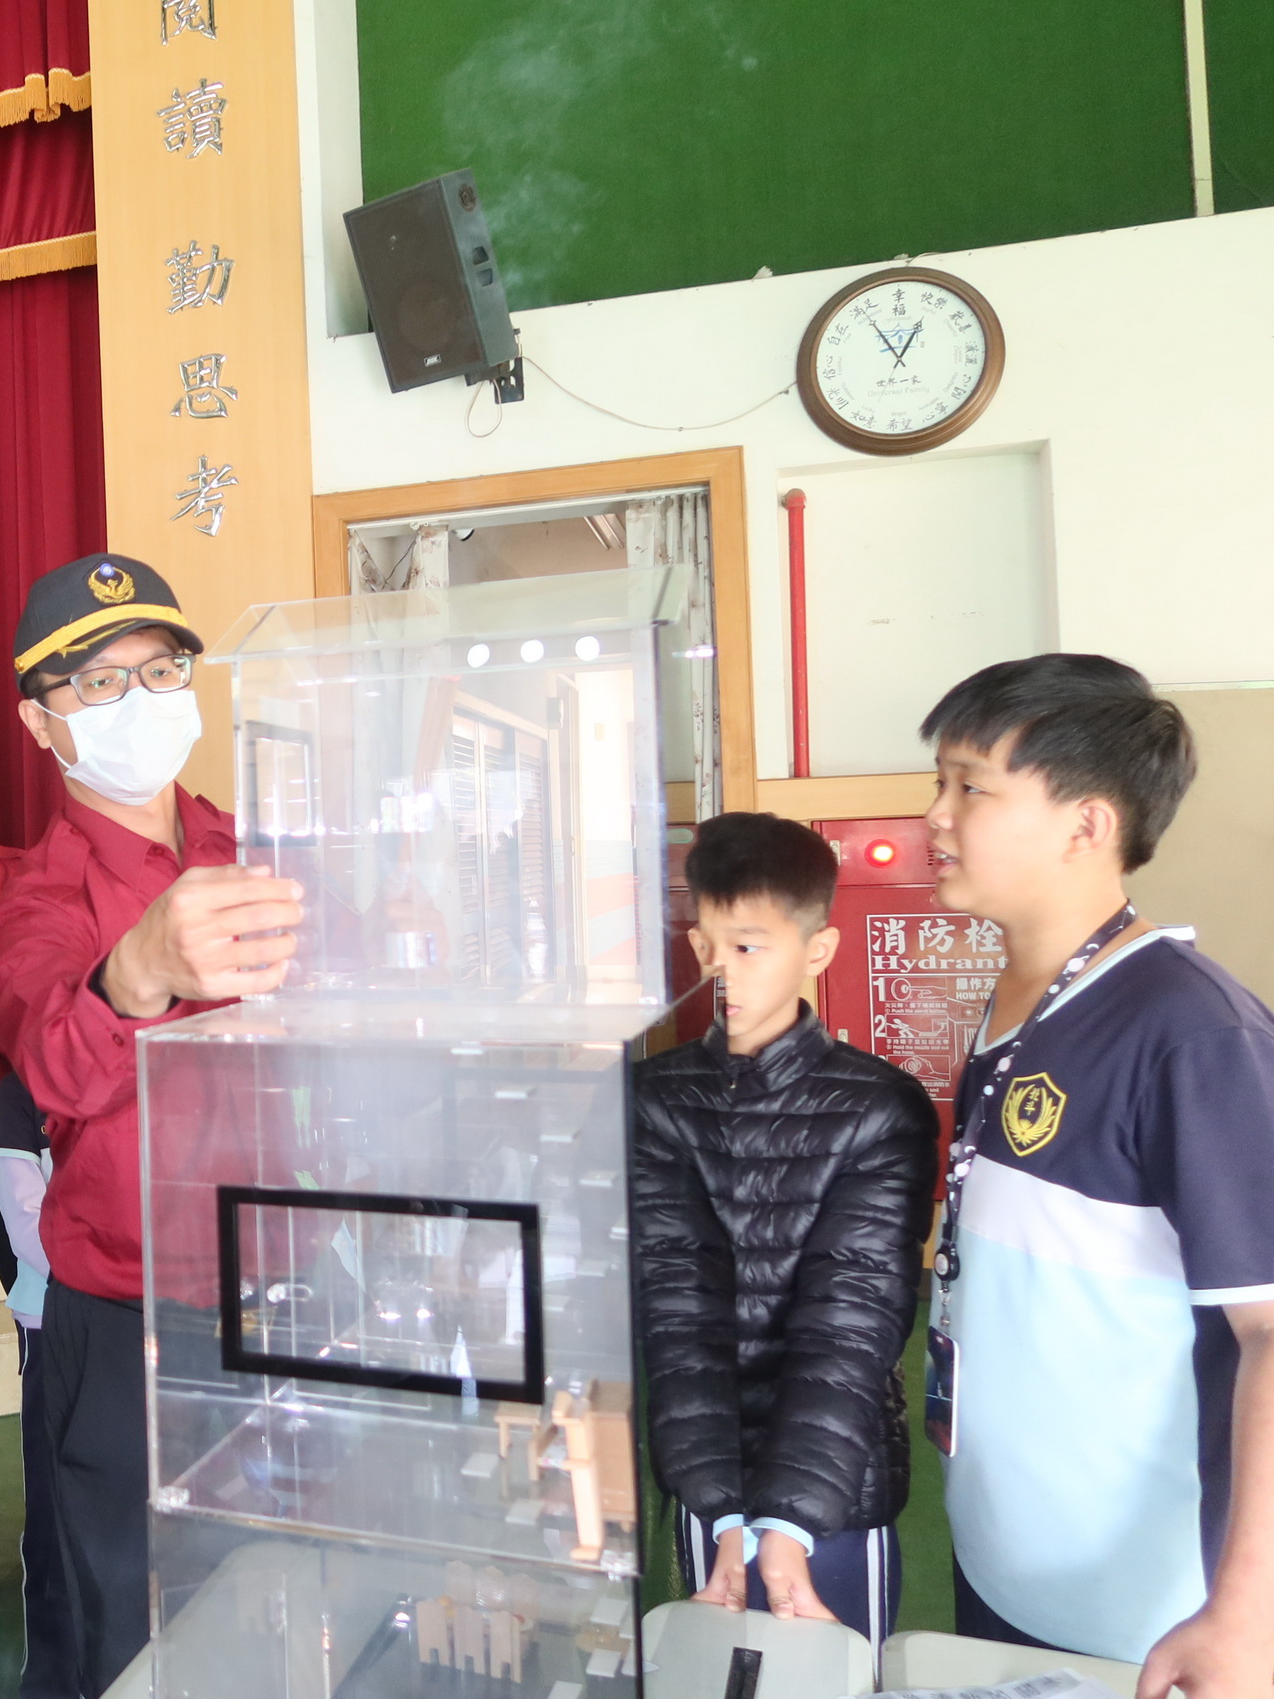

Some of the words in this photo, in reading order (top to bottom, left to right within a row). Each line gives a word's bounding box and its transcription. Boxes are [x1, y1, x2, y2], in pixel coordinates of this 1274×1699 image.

[849, 298, 879, 320] 滿足
[892, 288, 907, 317] 幸福
[920, 291, 948, 310] 快樂
[827, 323, 849, 346] 自在
[822, 354, 836, 380] 信心
[875, 375, 922, 388] 世界一家
[826, 387, 850, 410] 光明
[850, 410, 878, 429] 如意
[886, 418, 913, 432] 希望
[871, 917, 1004, 955] 消防栓
[872, 955, 1008, 973] Hydrant
[872, 977, 886, 1002] 1
[956, 992, 977, 1001] HOW
[874, 1014, 886, 1038] 2
